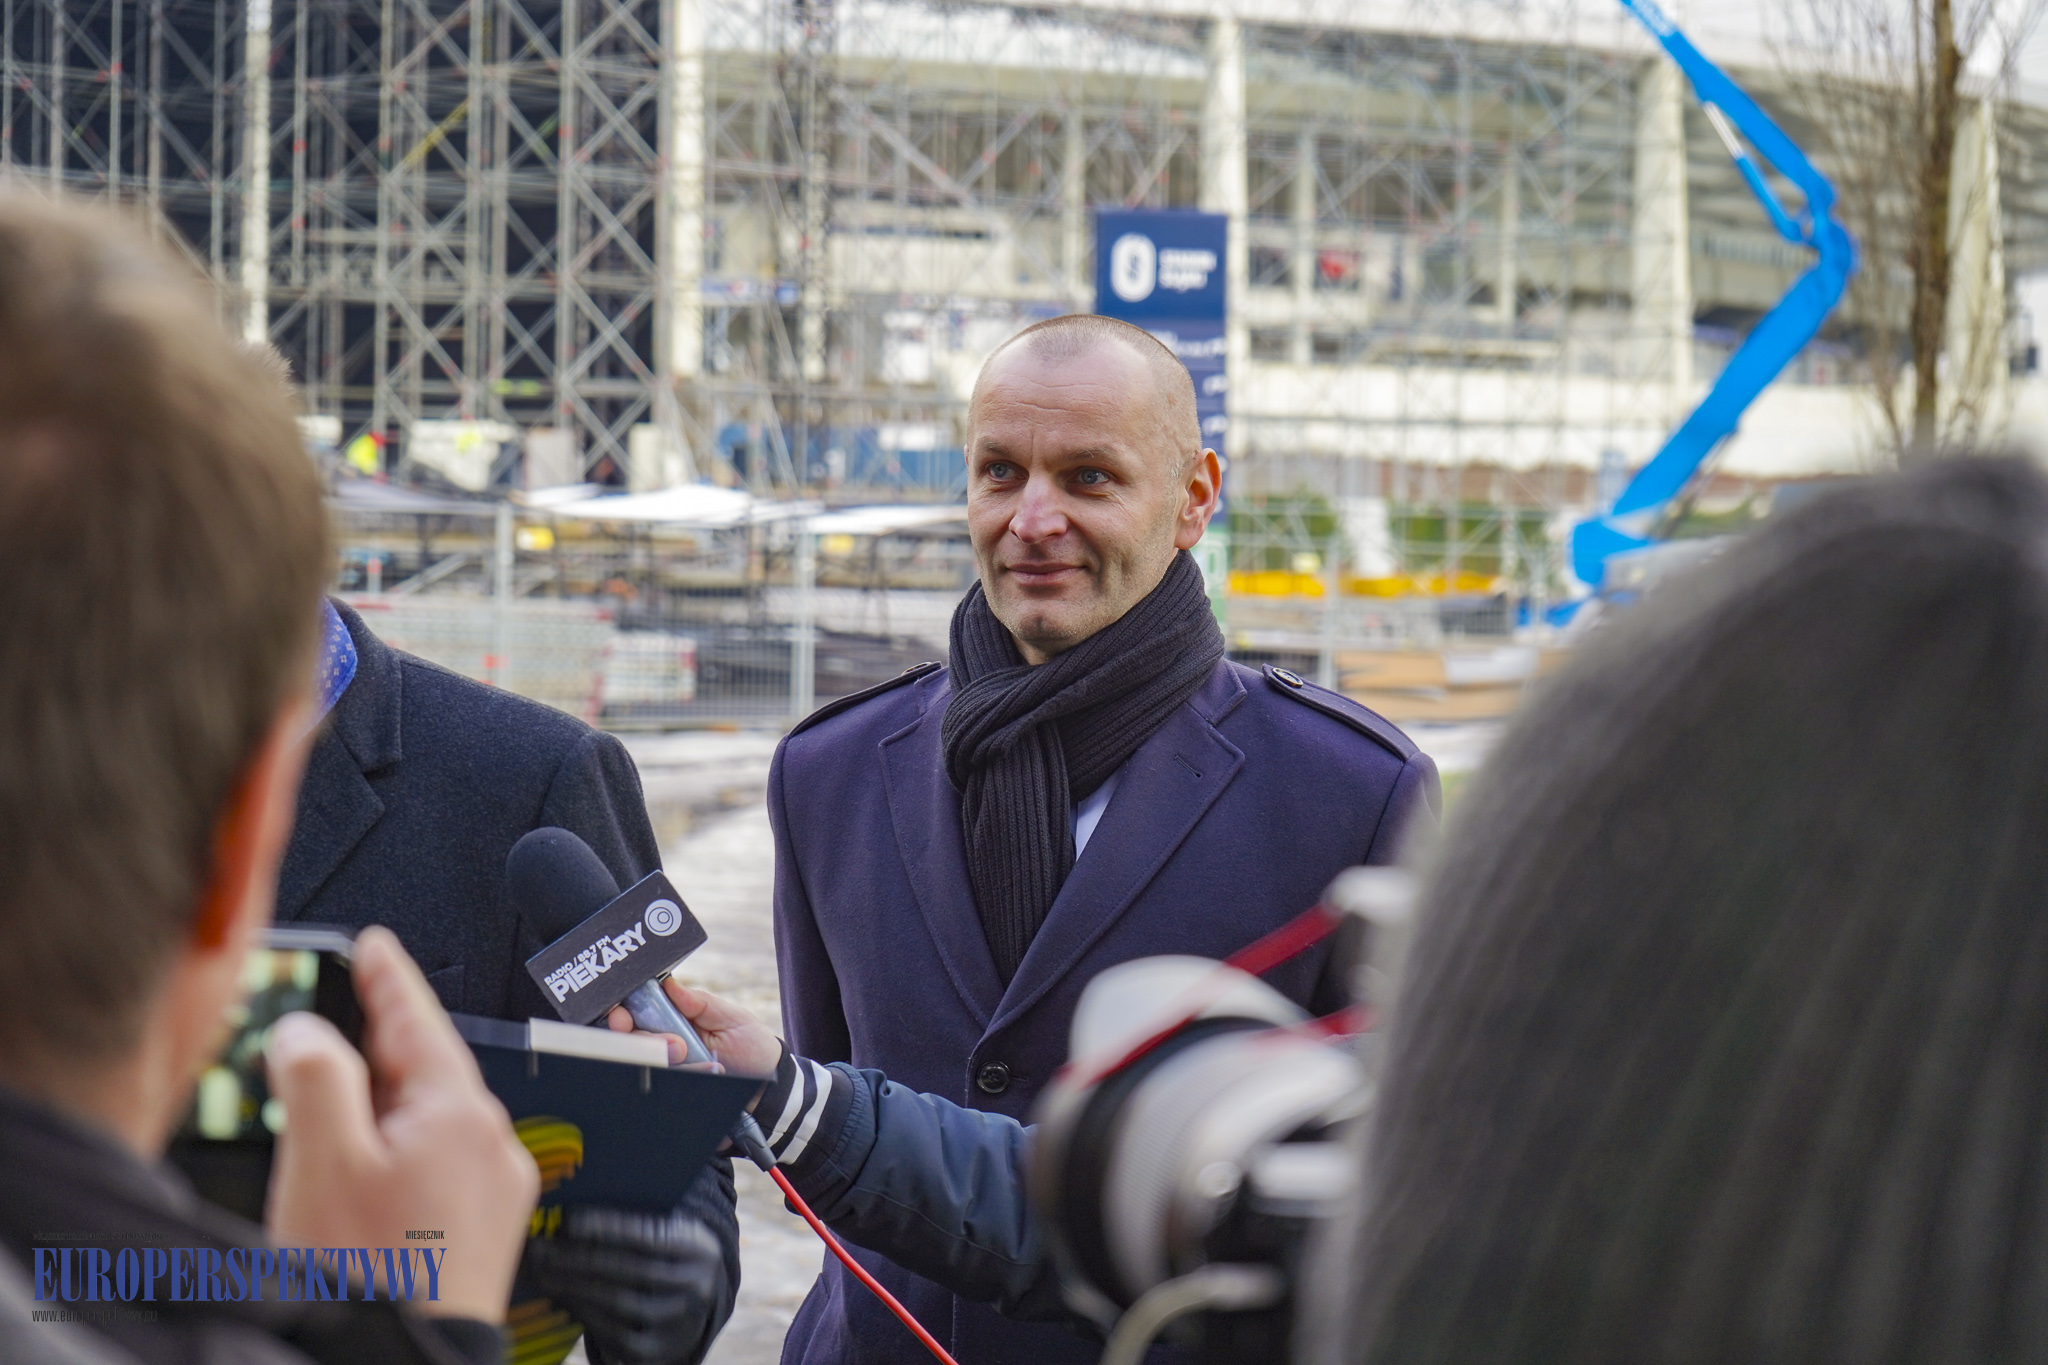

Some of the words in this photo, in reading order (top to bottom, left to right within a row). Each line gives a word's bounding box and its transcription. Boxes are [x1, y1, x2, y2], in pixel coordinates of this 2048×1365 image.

[544, 962, 573, 985] RADIO
[577, 945, 597, 962] 88.7
[596, 935, 612, 949] FM
[549, 921, 647, 1003] PIEKARY
